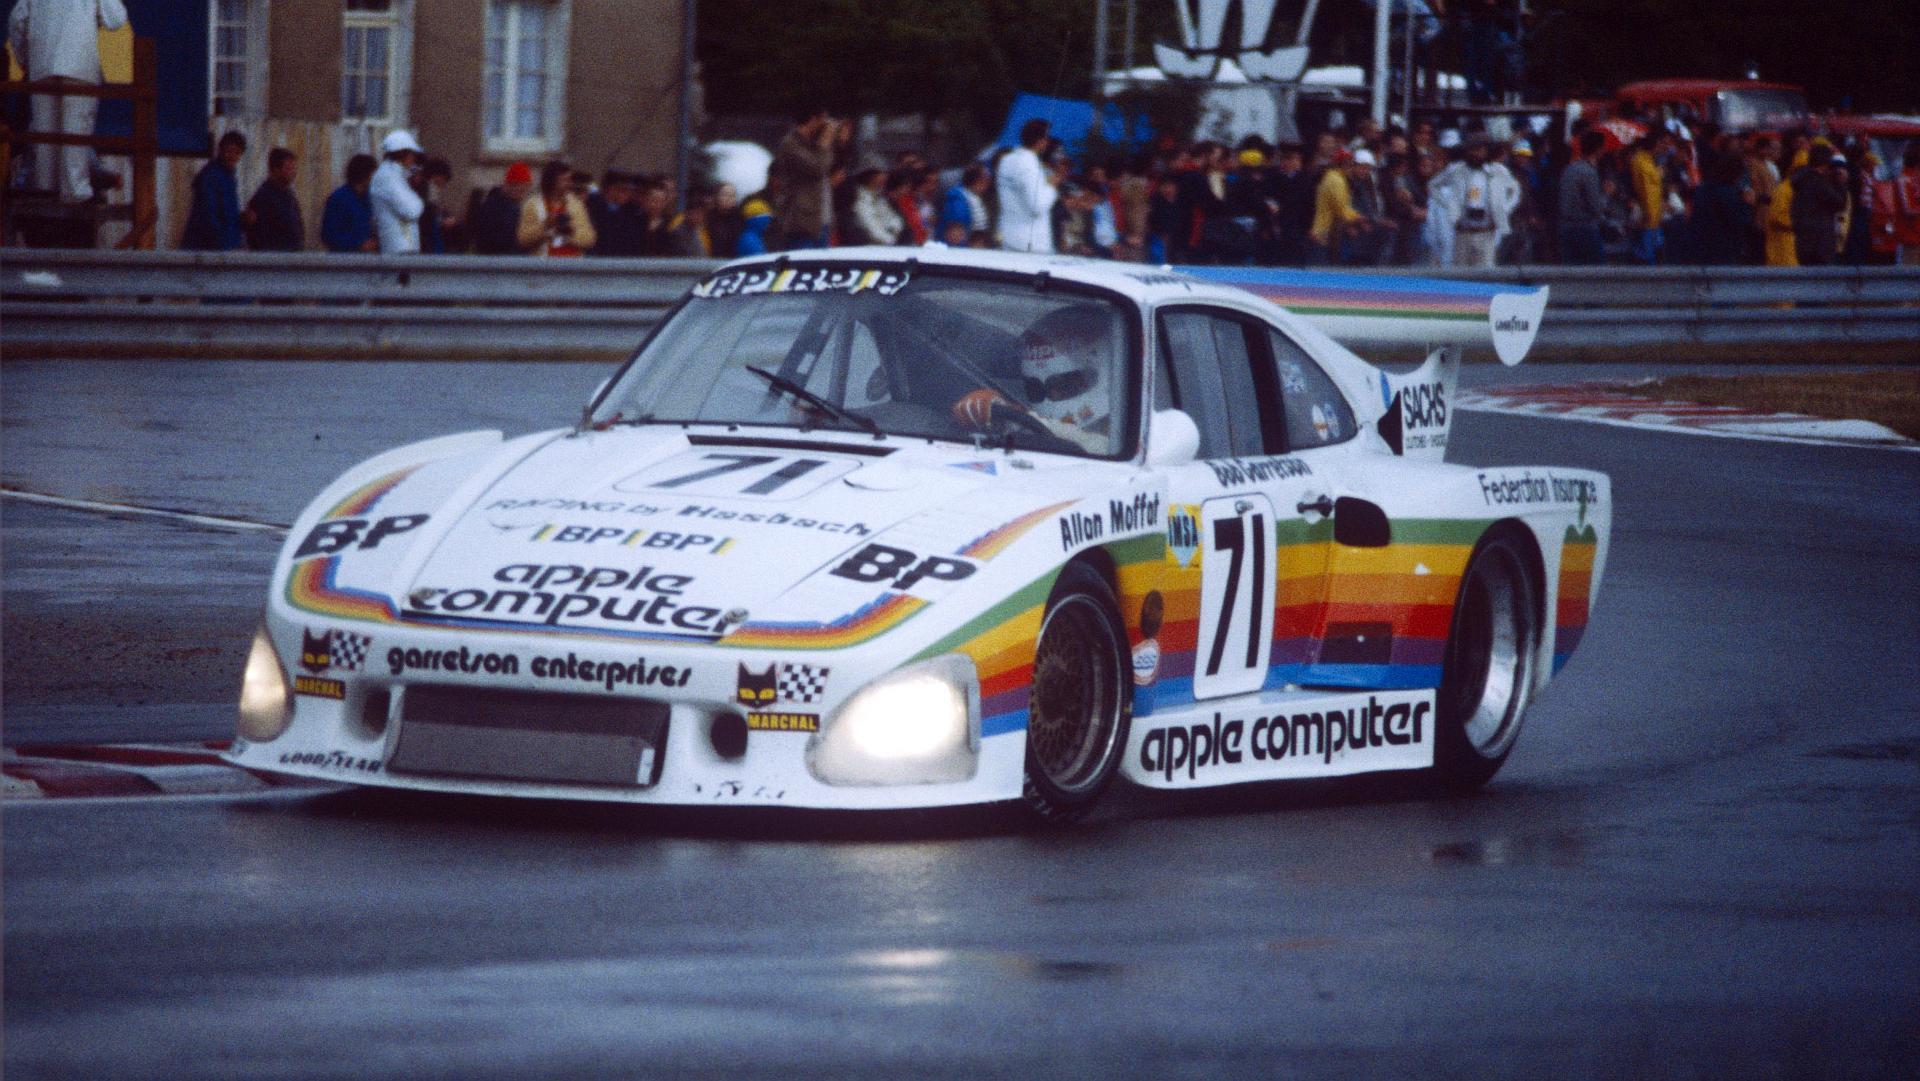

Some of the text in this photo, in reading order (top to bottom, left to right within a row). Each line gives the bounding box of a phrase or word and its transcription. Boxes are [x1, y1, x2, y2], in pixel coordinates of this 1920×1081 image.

[1403, 382, 1446, 430] SACHS
[649, 453, 830, 495] 71
[293, 513, 430, 560] BP
[551, 526, 716, 551] BP BP
[1060, 492, 1159, 552] Allan Moffat
[1167, 515, 1199, 547] IMSA
[494, 563, 695, 595] apple
[829, 543, 977, 591] BP
[409, 586, 741, 635] computer
[1206, 513, 1265, 677] 71
[387, 646, 692, 690] garretson enterprises
[749, 713, 817, 731] MARCHAL
[1140, 696, 1430, 782] apple computer
